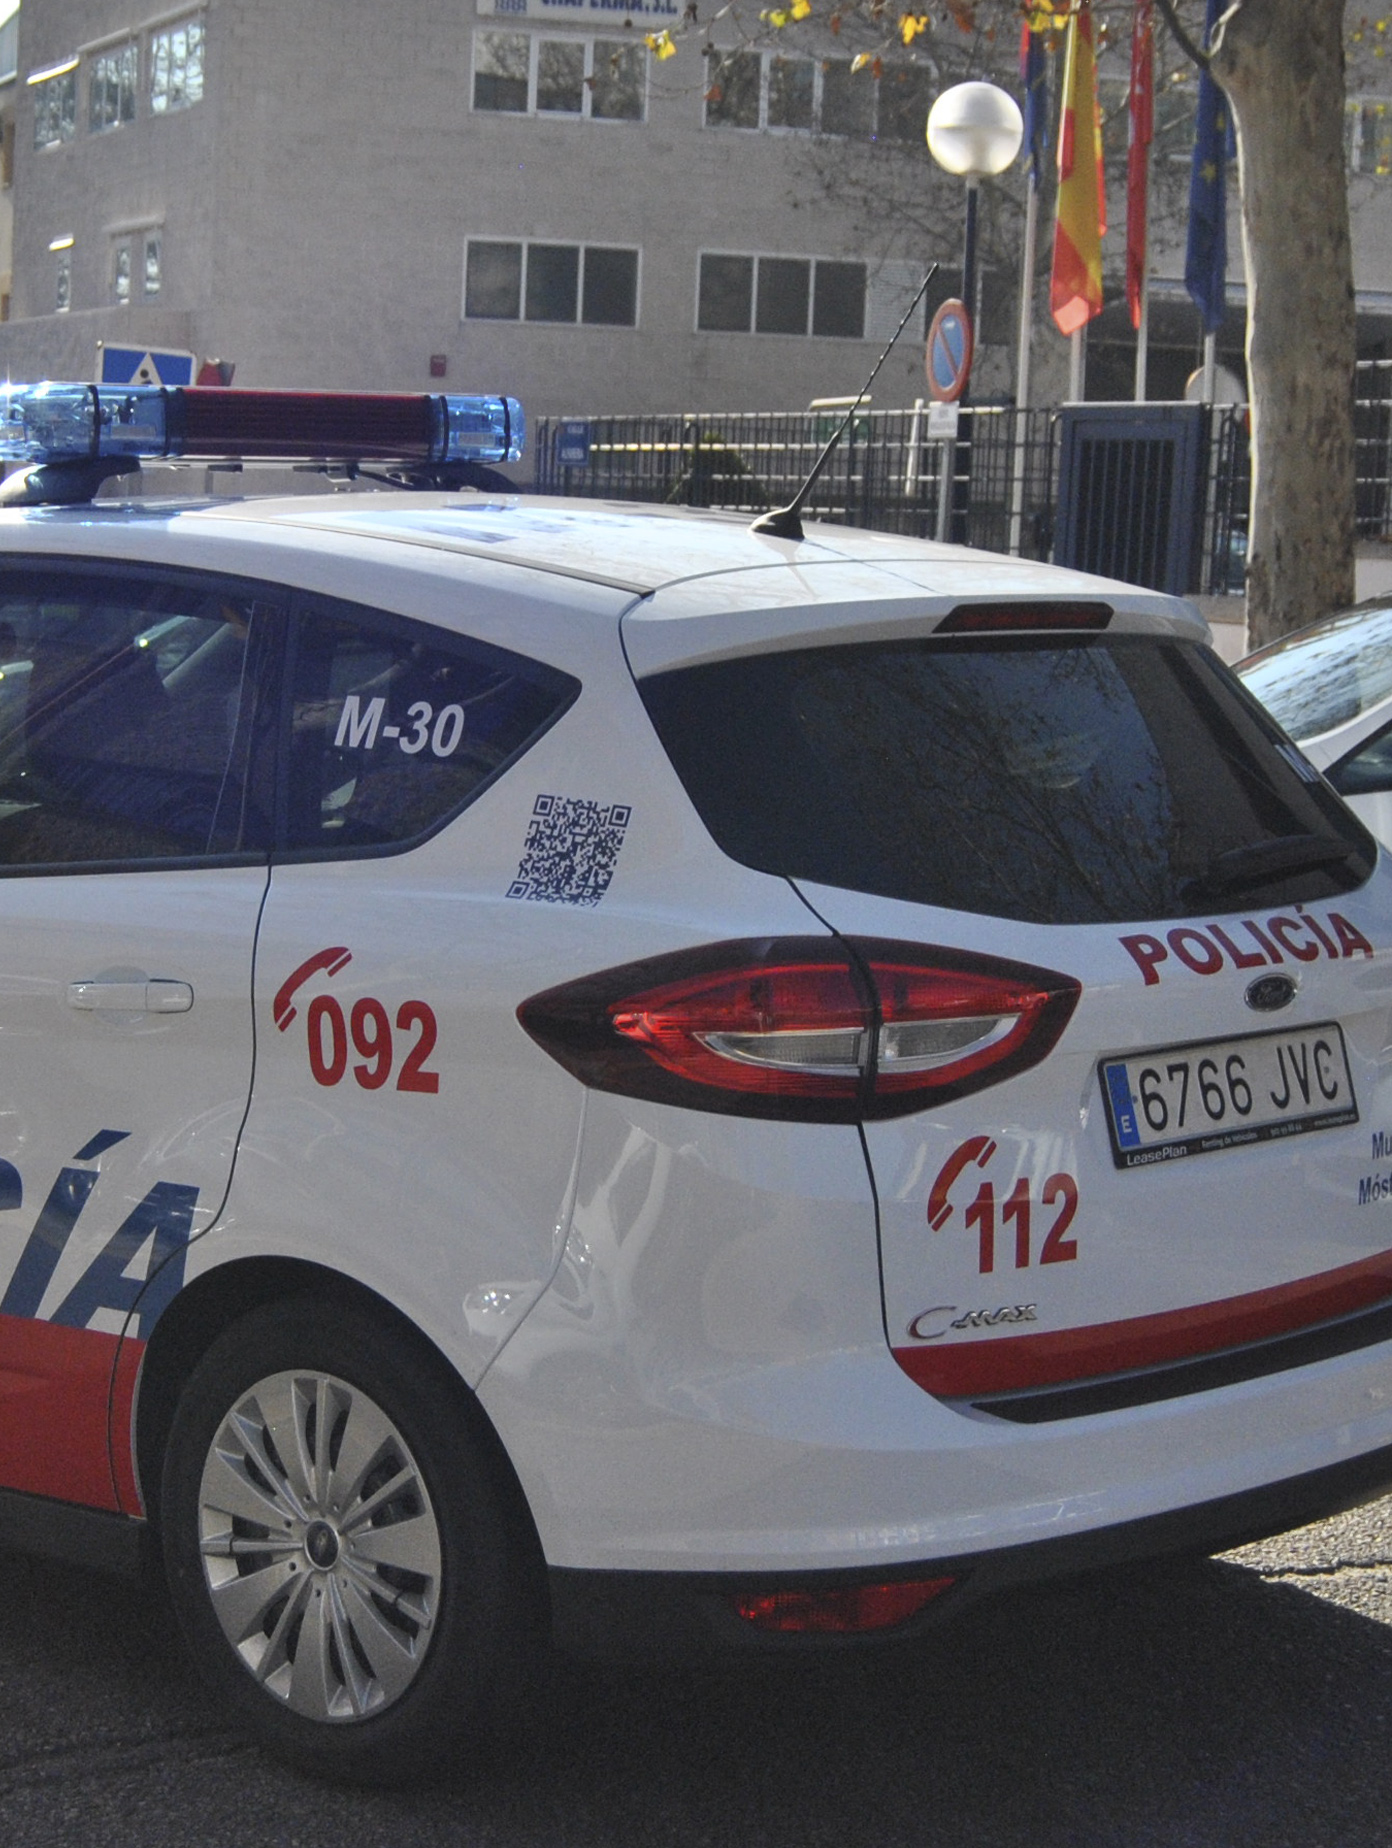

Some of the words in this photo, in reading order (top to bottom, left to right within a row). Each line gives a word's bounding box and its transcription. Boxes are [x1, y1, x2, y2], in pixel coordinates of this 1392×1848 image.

[333, 695, 465, 757] M-30
[1118, 904, 1374, 986] POLICÍA
[307, 994, 440, 1094] 092
[1120, 1115, 1133, 1134] E
[1138, 1054, 1253, 1131] 6766
[1269, 1040, 1339, 1109] JVC
[1126, 1144, 1187, 1167] LeasePlan
[965, 1172, 1079, 1274] 112
